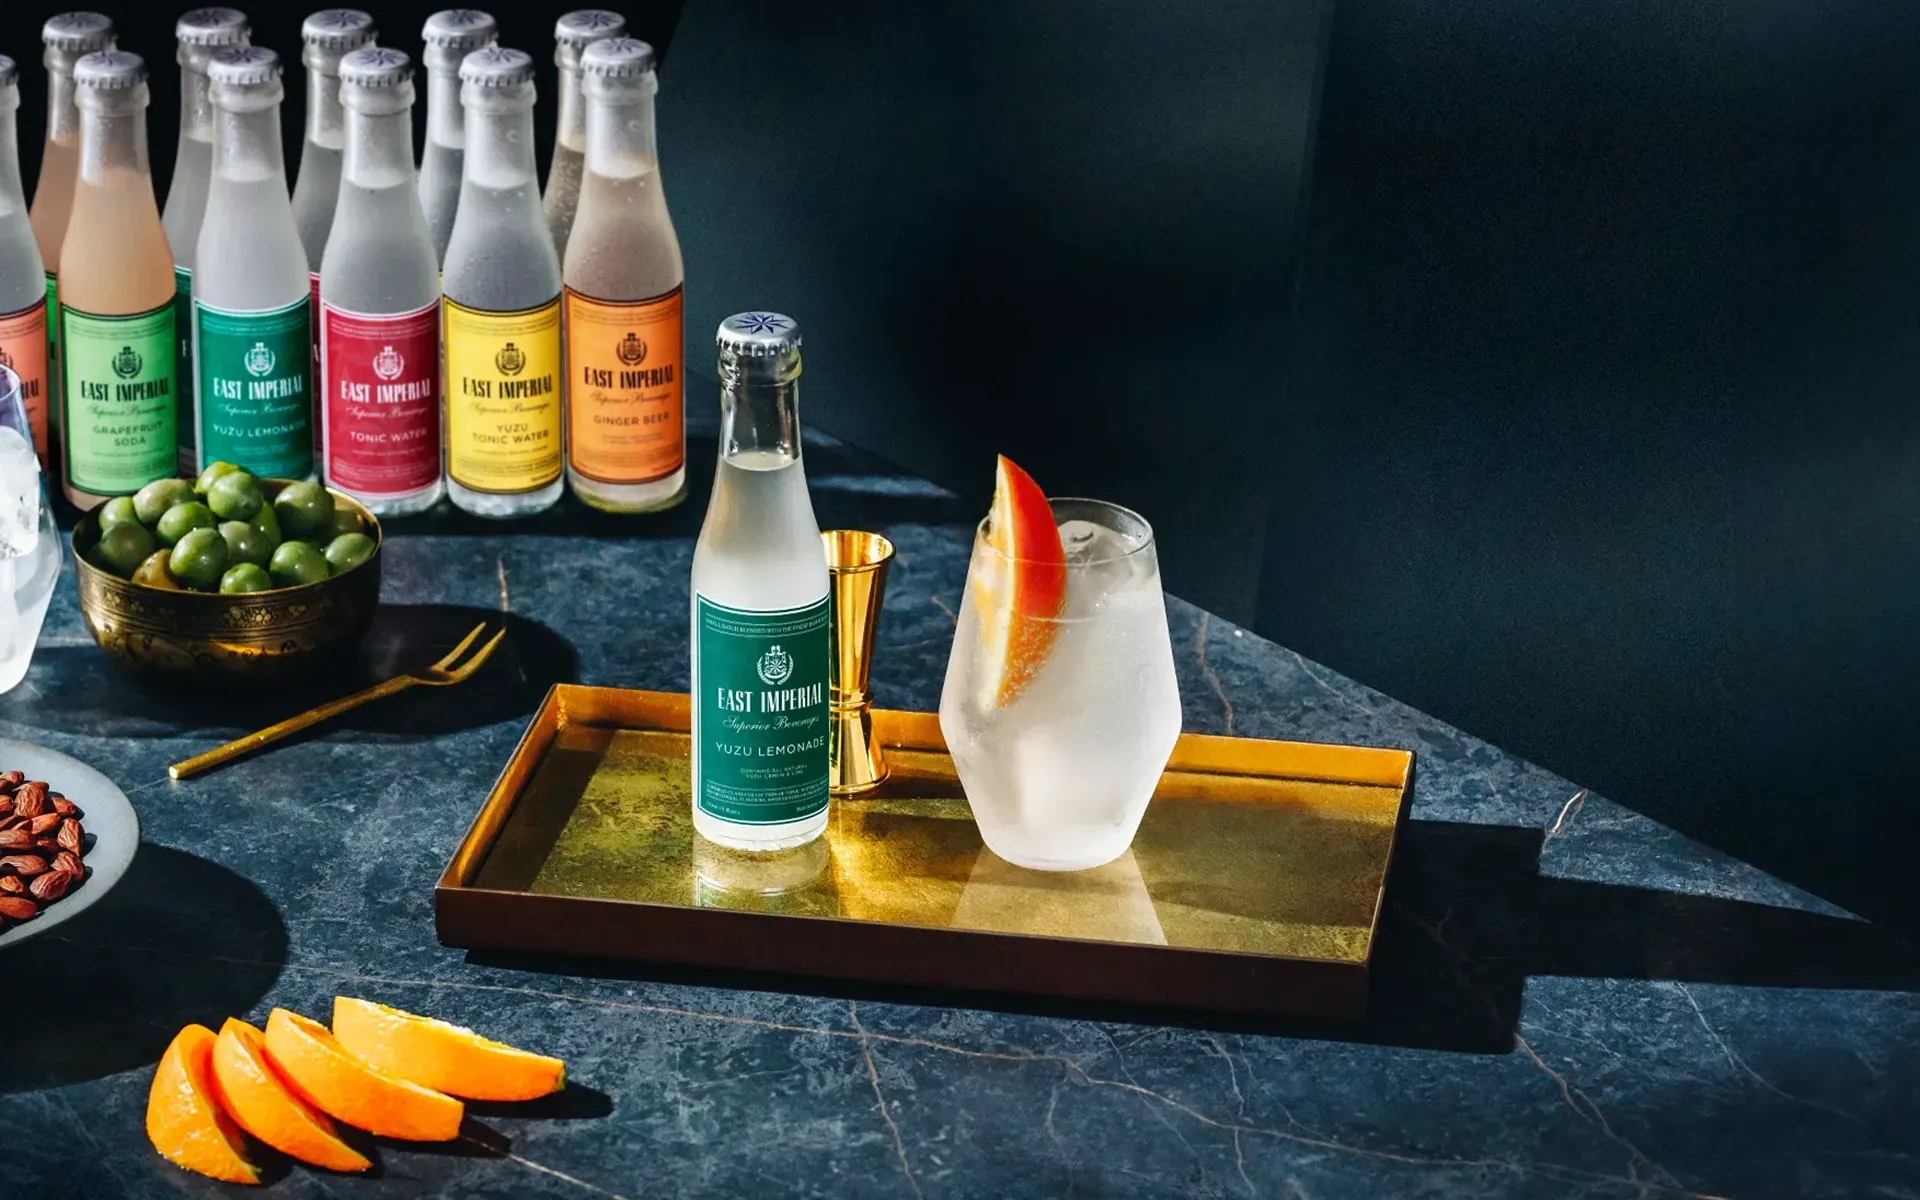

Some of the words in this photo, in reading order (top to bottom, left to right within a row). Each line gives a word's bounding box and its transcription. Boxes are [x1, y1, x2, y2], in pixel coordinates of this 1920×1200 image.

[584, 366, 614, 389] EAST
[620, 364, 674, 389] IMPERIAL
[81, 380, 109, 401] EAST
[116, 377, 169, 401] IMPERIAL
[213, 377, 242, 399] EAST
[248, 375, 303, 400] IMPERIAL
[341, 380, 371, 403] EAST
[377, 378, 432, 403] IMPERIAL
[463, 376, 492, 399] EAST
[499, 374, 553, 400] IMPERIAL
[594, 414, 640, 426] GINGER
[643, 411, 670, 425] BEER
[92, 421, 163, 435] GRAPEFRUIT
[213, 422, 243, 437] YUZU
[350, 431, 387, 443] TONIC
[391, 428, 427, 442] WATER
[473, 432, 508, 445] TONIC
[512, 429, 549, 444] WATER
[496, 423, 529, 434] YUZU
[114, 436, 146, 446] SODA
[717, 687, 753, 713] EAST
[761, 682, 823, 713] IMPERIAL
[722, 715, 770, 733] Superior
[715, 741, 753, 757] YUZU
[758, 735, 825, 757] LEMONADE
